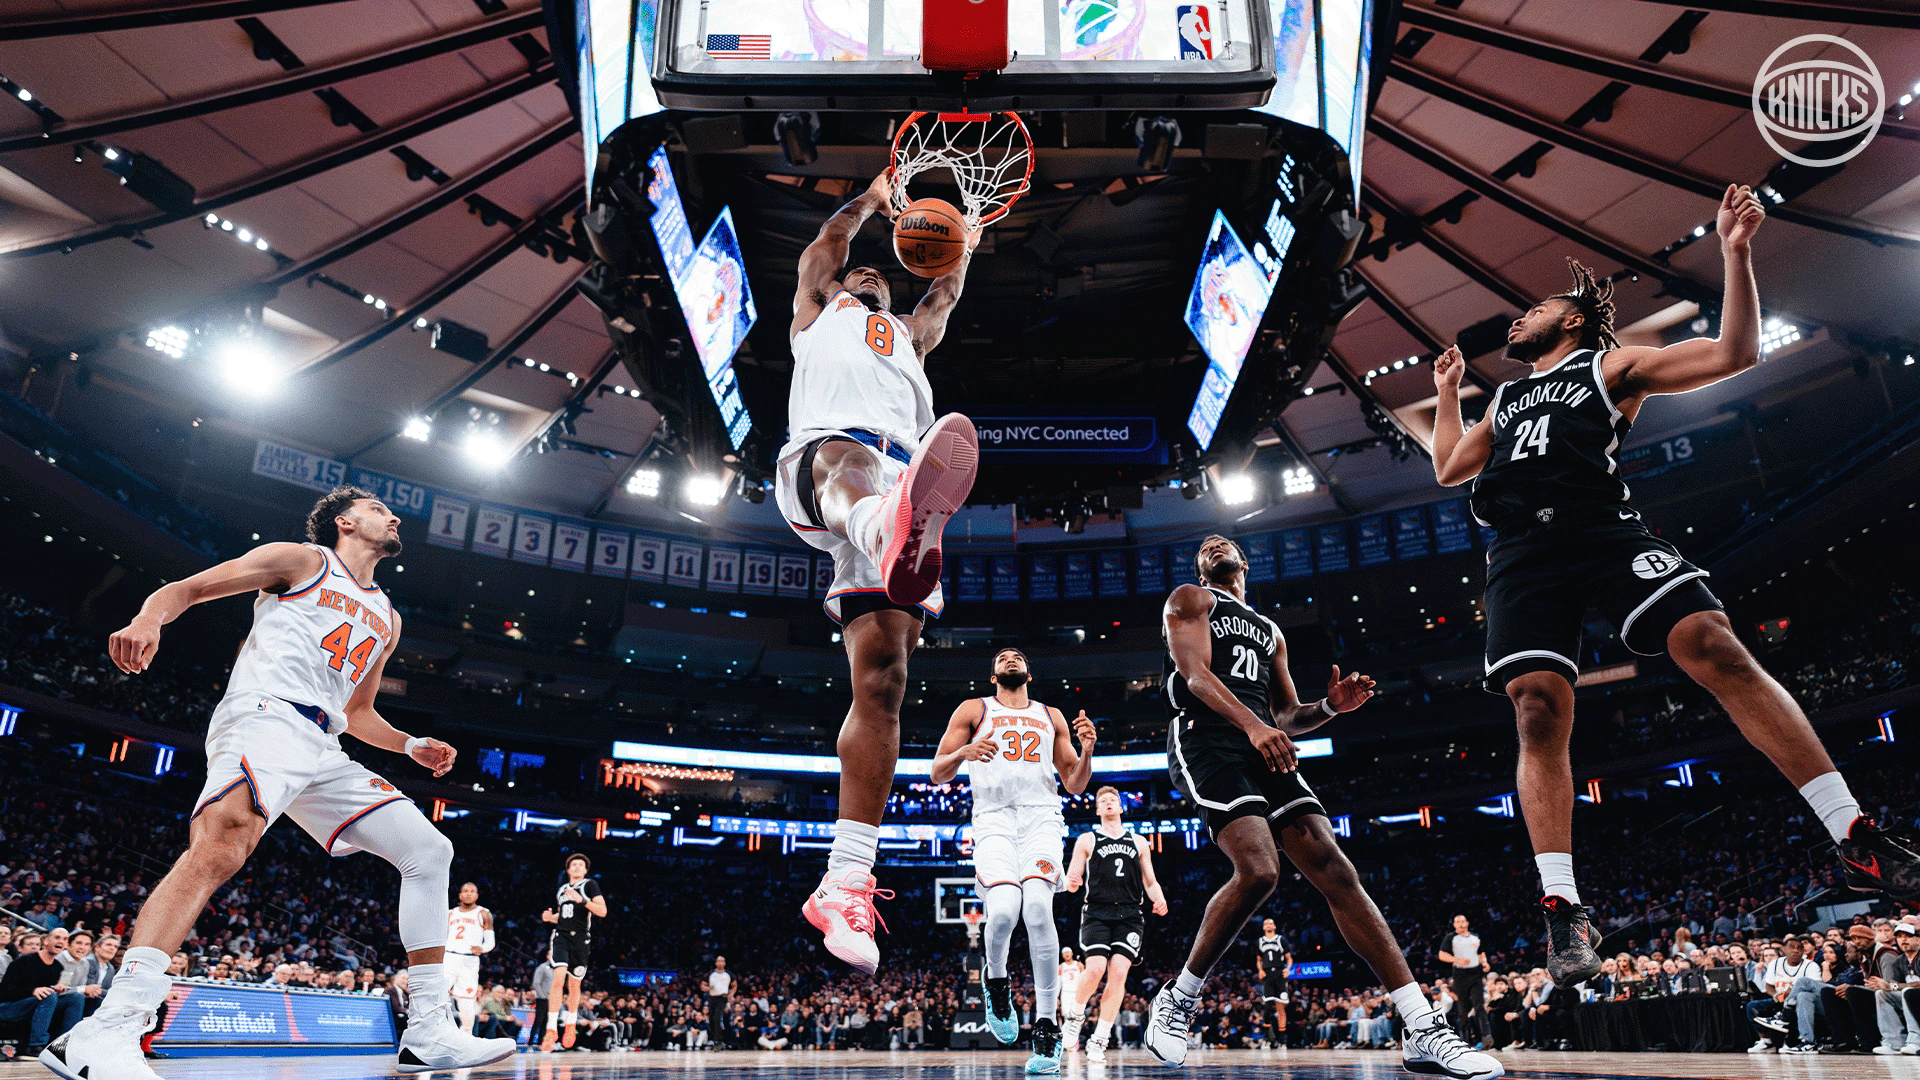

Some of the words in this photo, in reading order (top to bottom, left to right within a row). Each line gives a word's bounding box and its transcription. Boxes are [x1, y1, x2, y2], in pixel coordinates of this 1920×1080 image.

[900, 216, 950, 237] Wilson
[864, 313, 894, 357] 8
[1497, 381, 1593, 429] BROOKLYN
[1006, 426, 1041, 441] NYC
[1043, 425, 1129, 441] Connected
[1510, 413, 1551, 461] 24
[1661, 437, 1694, 462] 13
[313, 460, 343, 486] 15
[383, 480, 426, 510] 150
[441, 512, 453, 536] 1
[484, 522, 501, 545] 2
[525, 530, 541, 552] 3
[564, 537, 578, 559] 7
[604, 544, 618, 565] 9
[642, 550, 656, 571] 9
[674, 554, 694, 577] 11
[1644, 553, 1670, 575] B
[713, 560, 733, 582] 11
[748, 563, 772, 585] 19
[780, 566, 807, 587] 30
[317, 588, 361, 618] NEW
[361, 605, 392, 647] YORK
[1210, 616, 1275, 656] BROOKLYN
[320, 621, 377, 685] 44
[1230, 644, 1259, 681] 20
[992, 715, 1018, 729] NEW
[1019, 716, 1049, 733] YORK
[1002, 730, 1040, 762] 32
[1097, 843, 1137, 858] BROOKLYN
[1114, 858, 1125, 877] 2
[455, 925, 466, 939] 2
[1267, 950, 1274, 961] 1
[1301, 965, 1331, 975] ULTRA
